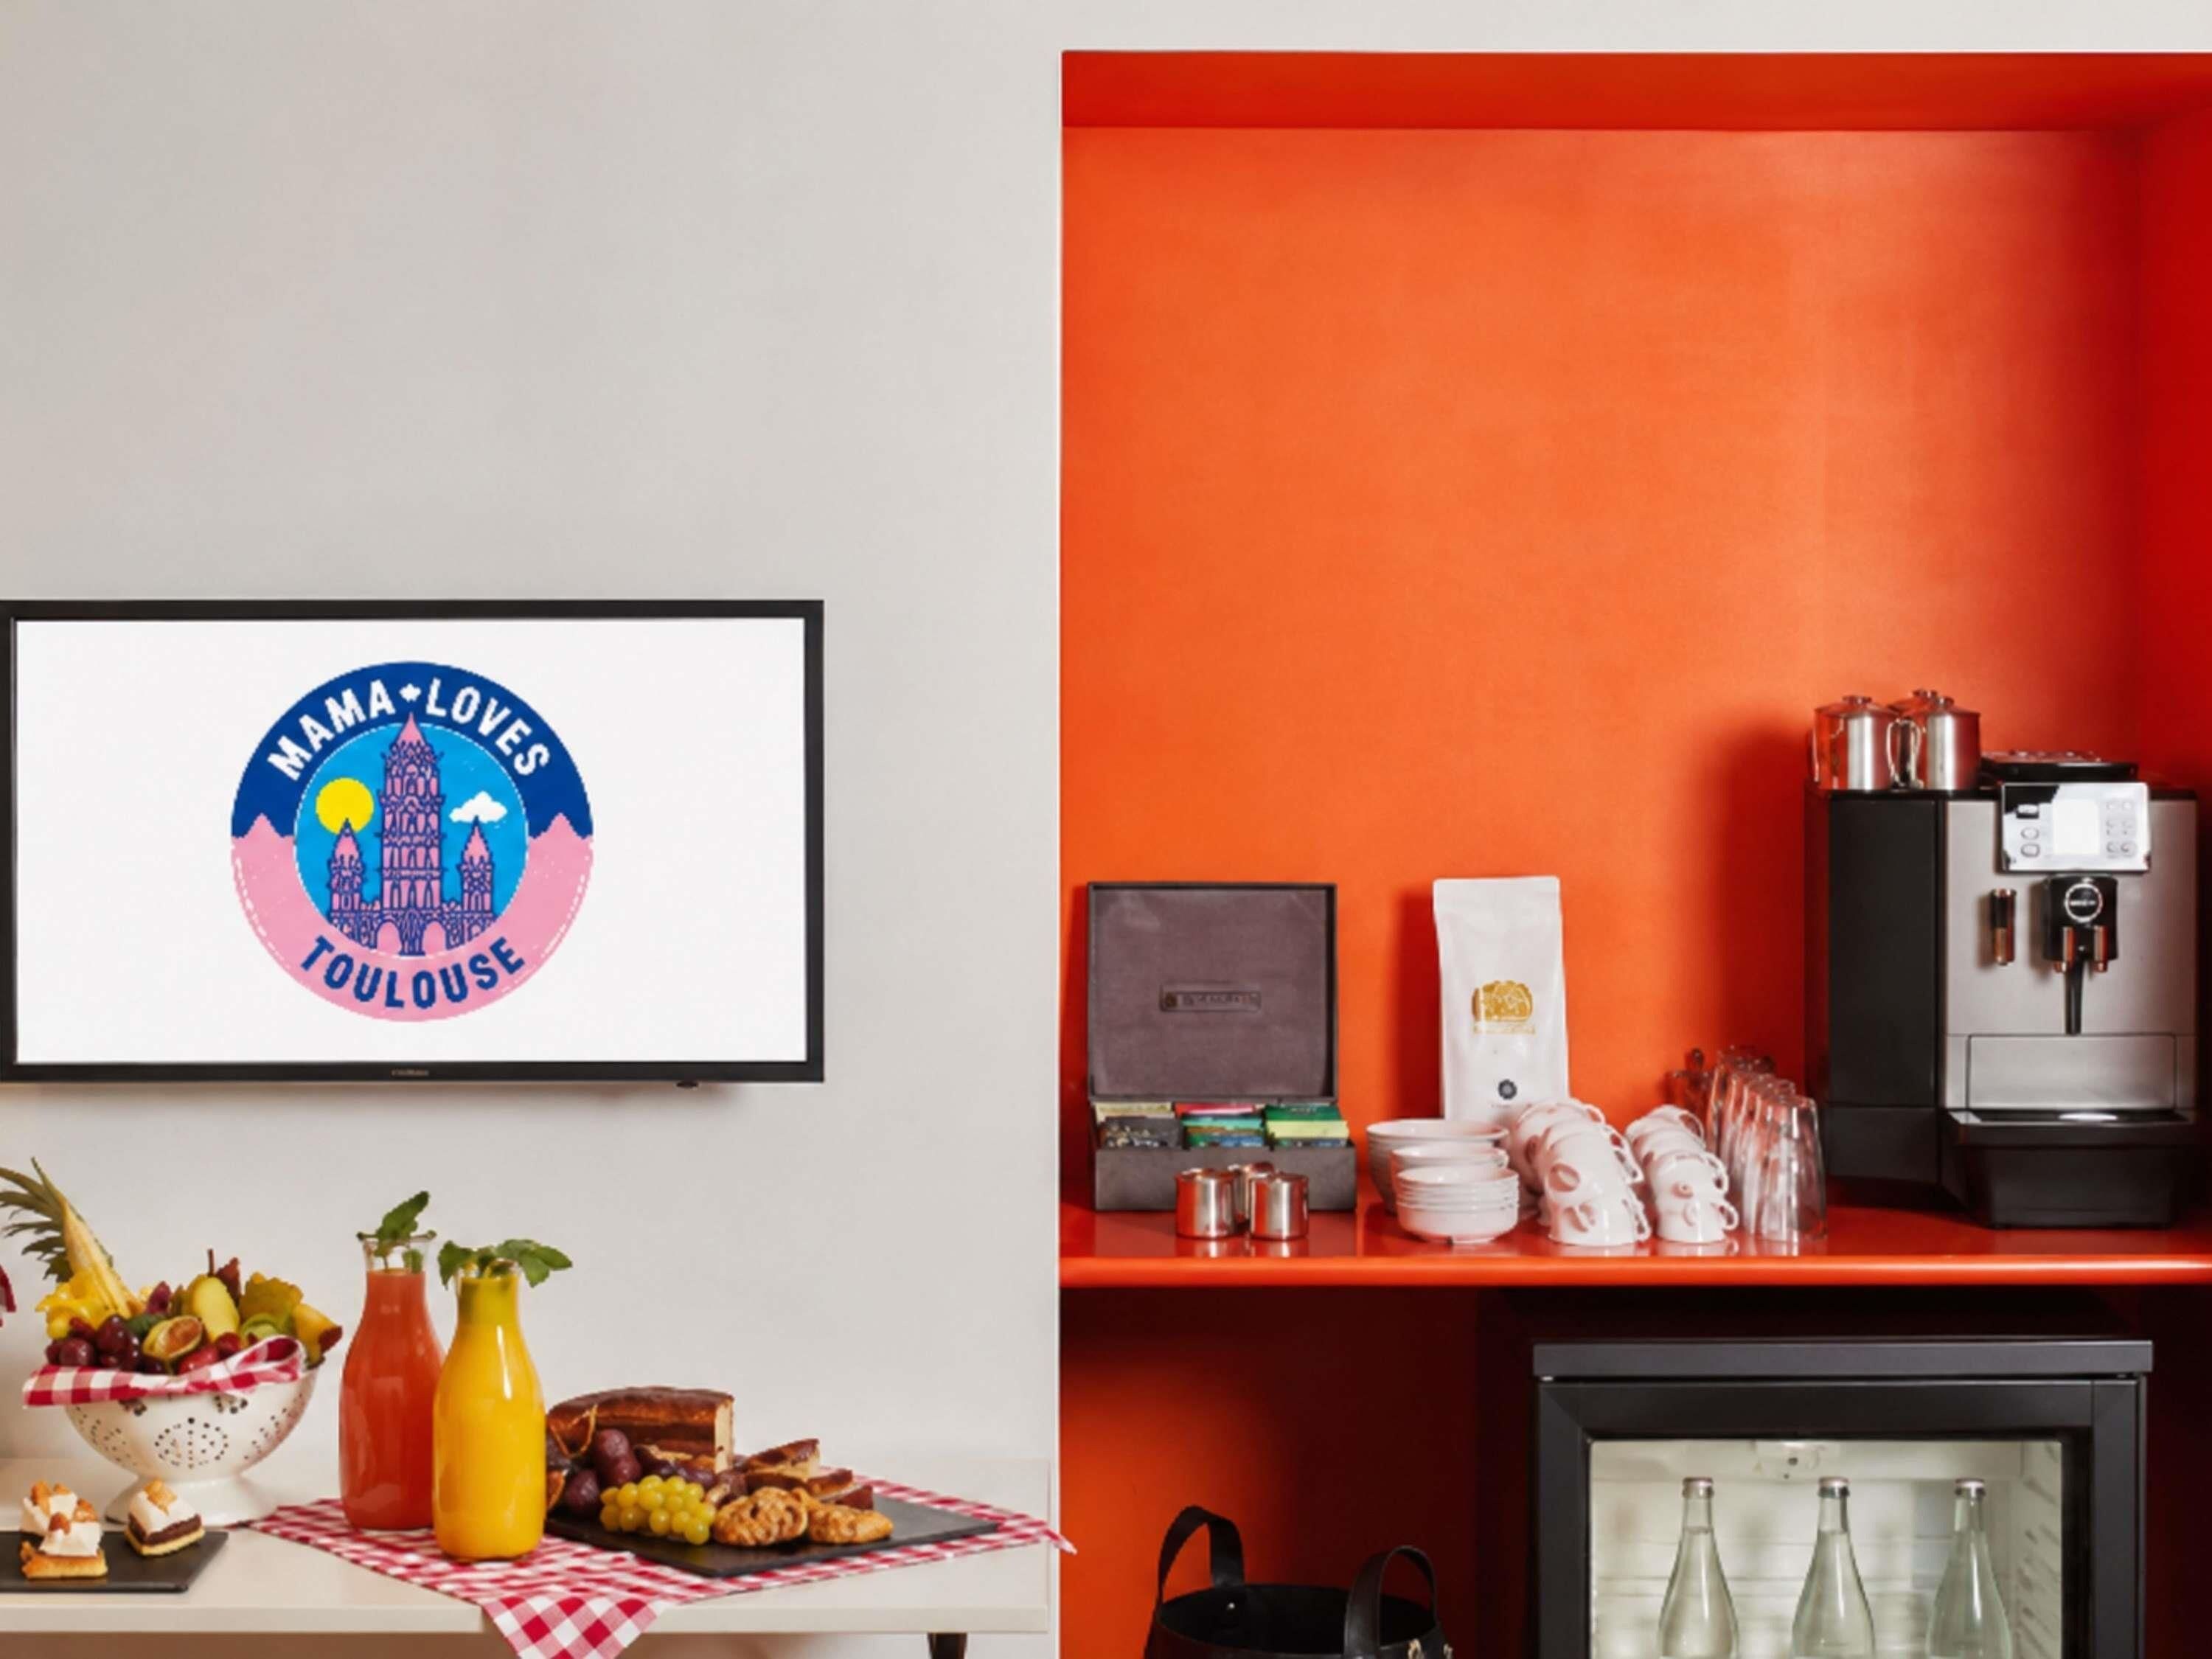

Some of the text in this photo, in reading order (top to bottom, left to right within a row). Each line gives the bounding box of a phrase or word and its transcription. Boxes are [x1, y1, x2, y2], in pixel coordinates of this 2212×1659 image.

[268, 678, 550, 780] MAMA LOVES
[300, 935, 526, 1009] TOULOUSE
